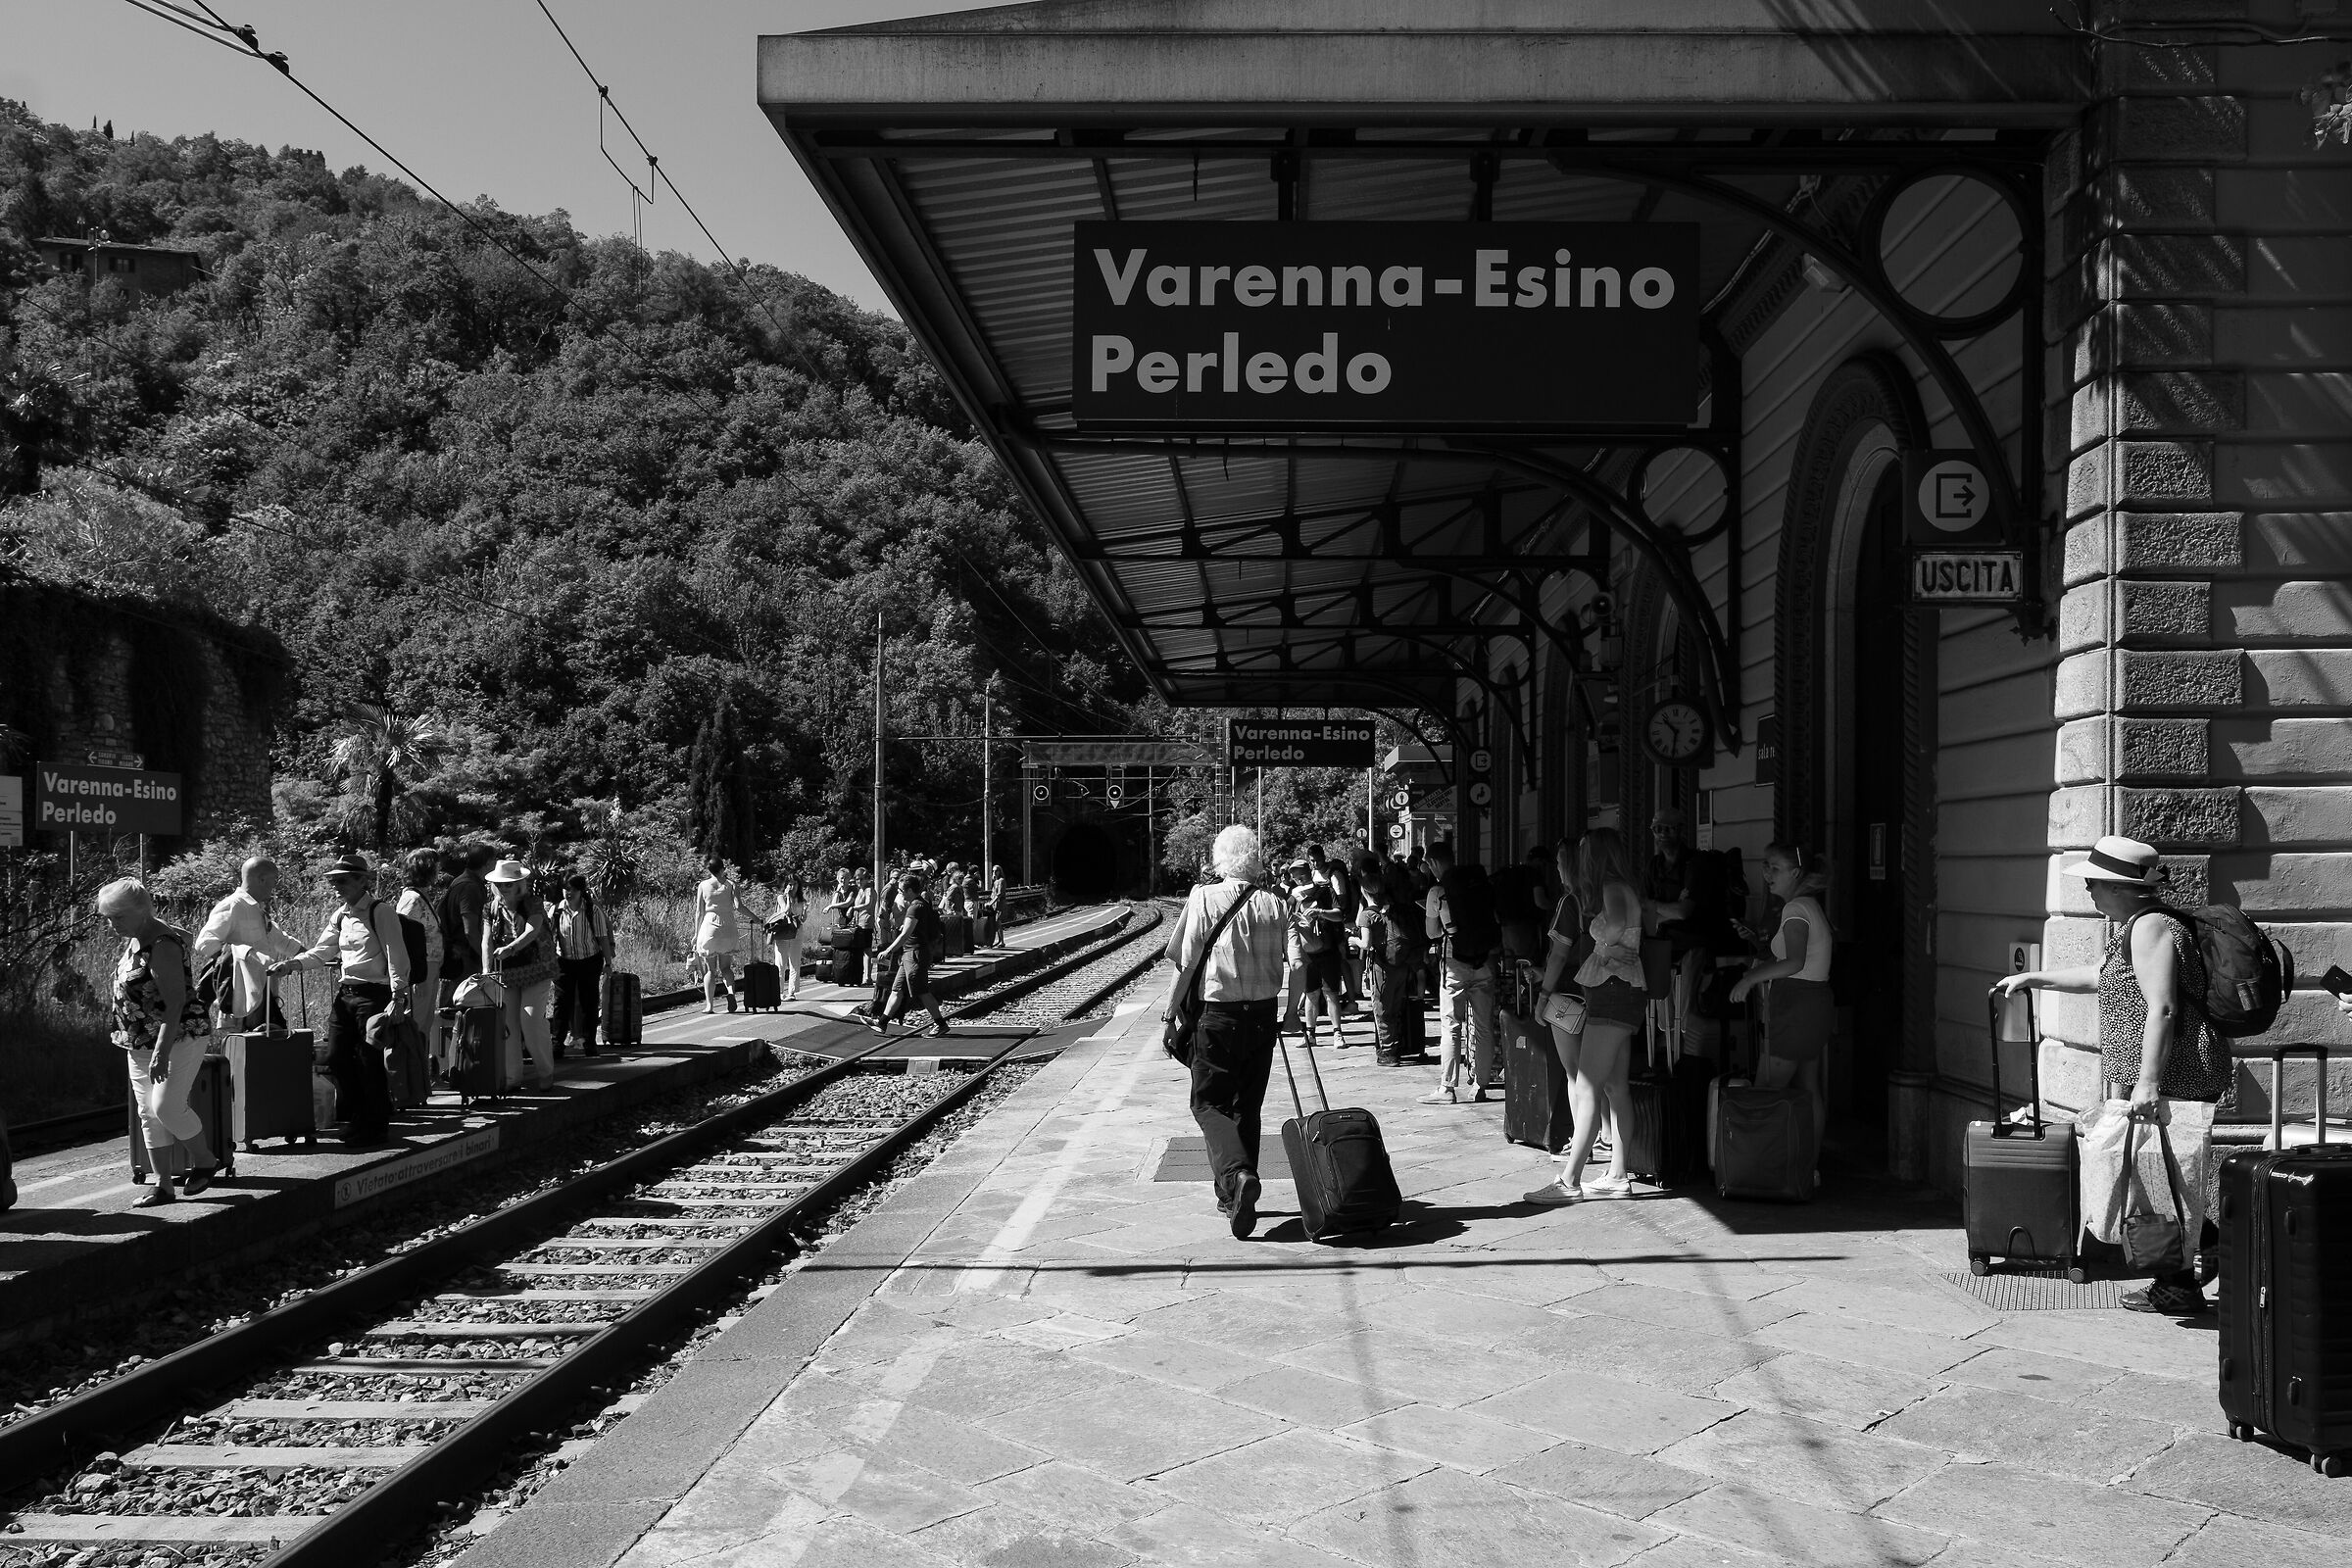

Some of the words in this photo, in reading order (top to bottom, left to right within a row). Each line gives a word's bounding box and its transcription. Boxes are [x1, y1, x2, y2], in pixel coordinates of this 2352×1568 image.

[1092, 247, 1676, 309] Varenna-Esino
[1091, 331, 1393, 394] Perledo
[1922, 561, 2014, 593] USCITA
[1234, 725, 1370, 741] Varenna-Esino
[1233, 745, 1305, 760] Perledo
[43, 771, 177, 801] Varenna-Esino
[42, 801, 117, 825] Perledo
[357, 1172, 395, 1196] Vietato
[397, 1151, 459, 1182] attraversare
[466, 1134, 491, 1157] binari
